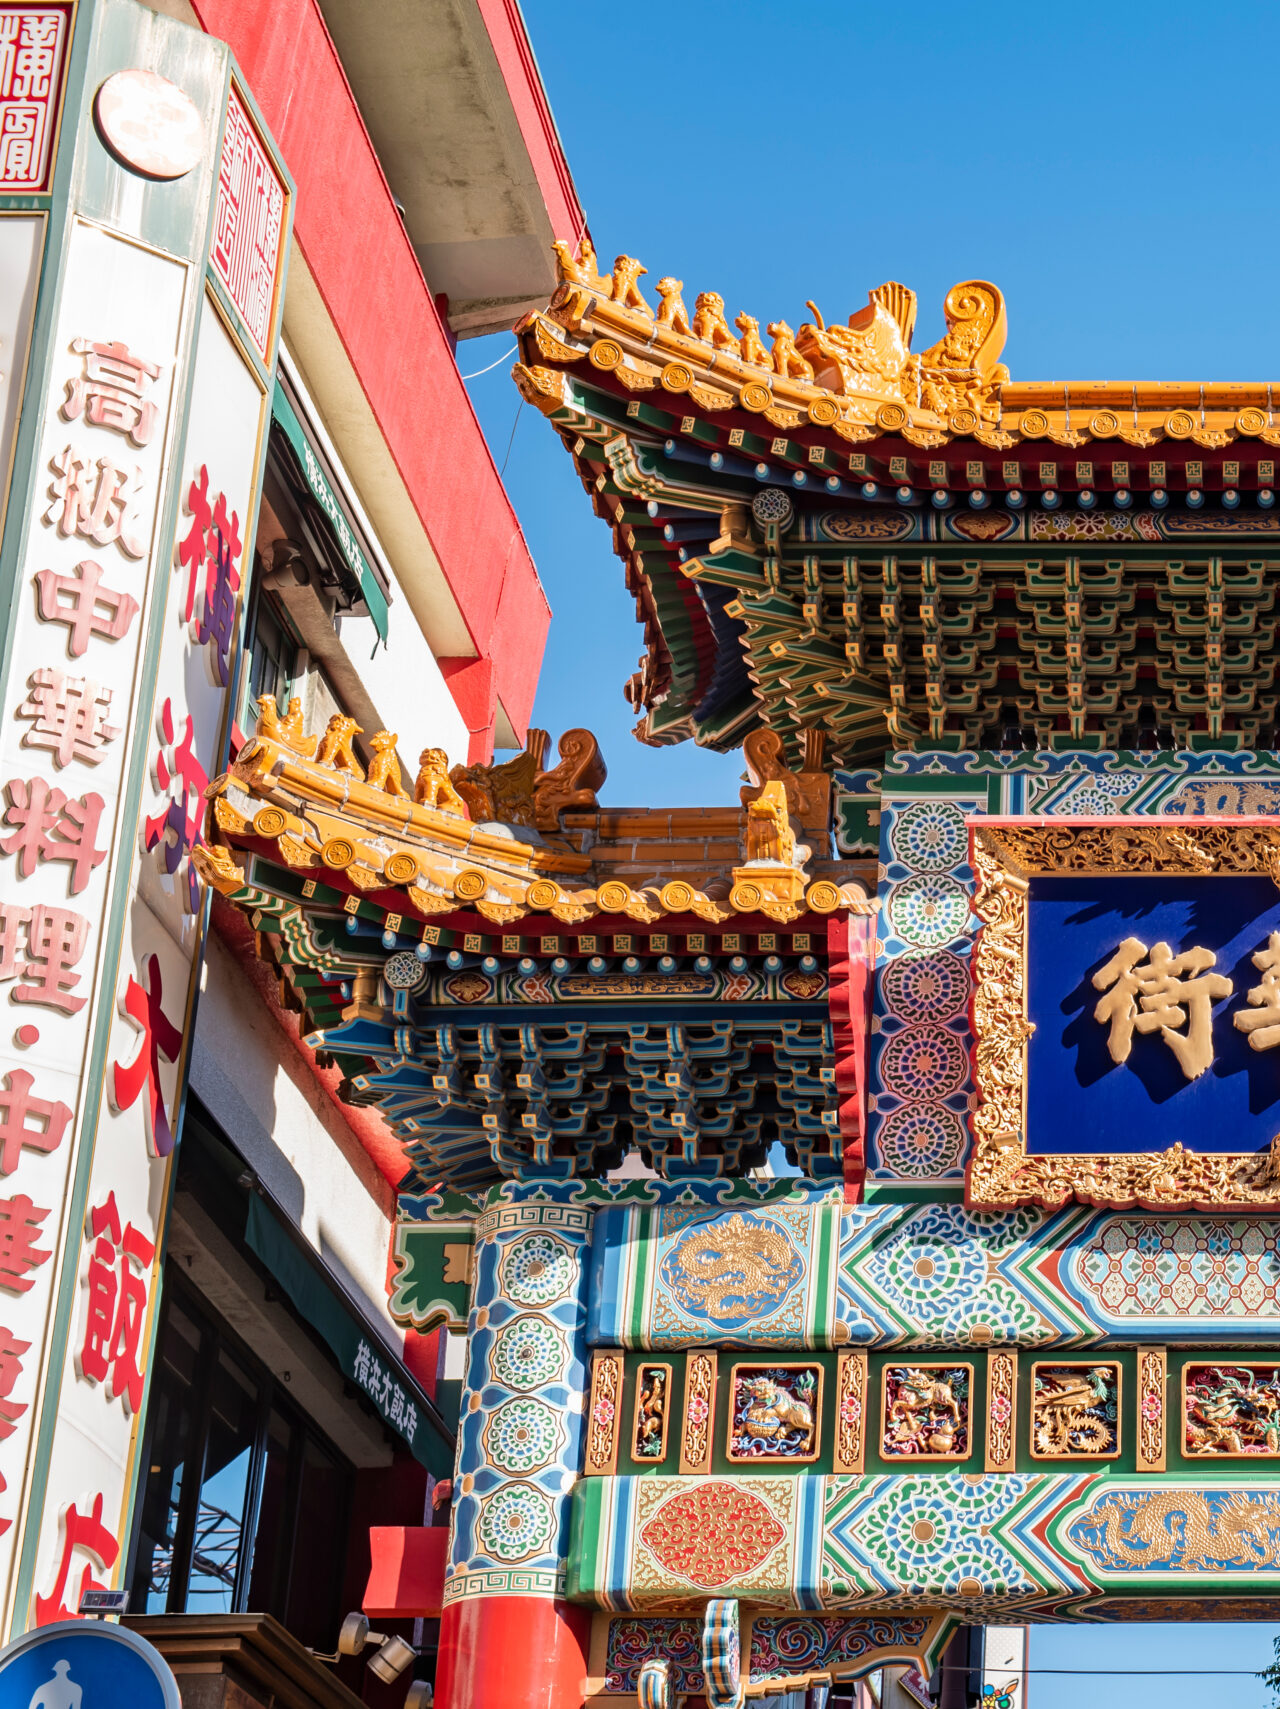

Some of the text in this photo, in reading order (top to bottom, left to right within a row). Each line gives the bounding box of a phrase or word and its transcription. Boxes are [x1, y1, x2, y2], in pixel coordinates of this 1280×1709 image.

[353, 1338, 418, 1444] 横浜大飯店
